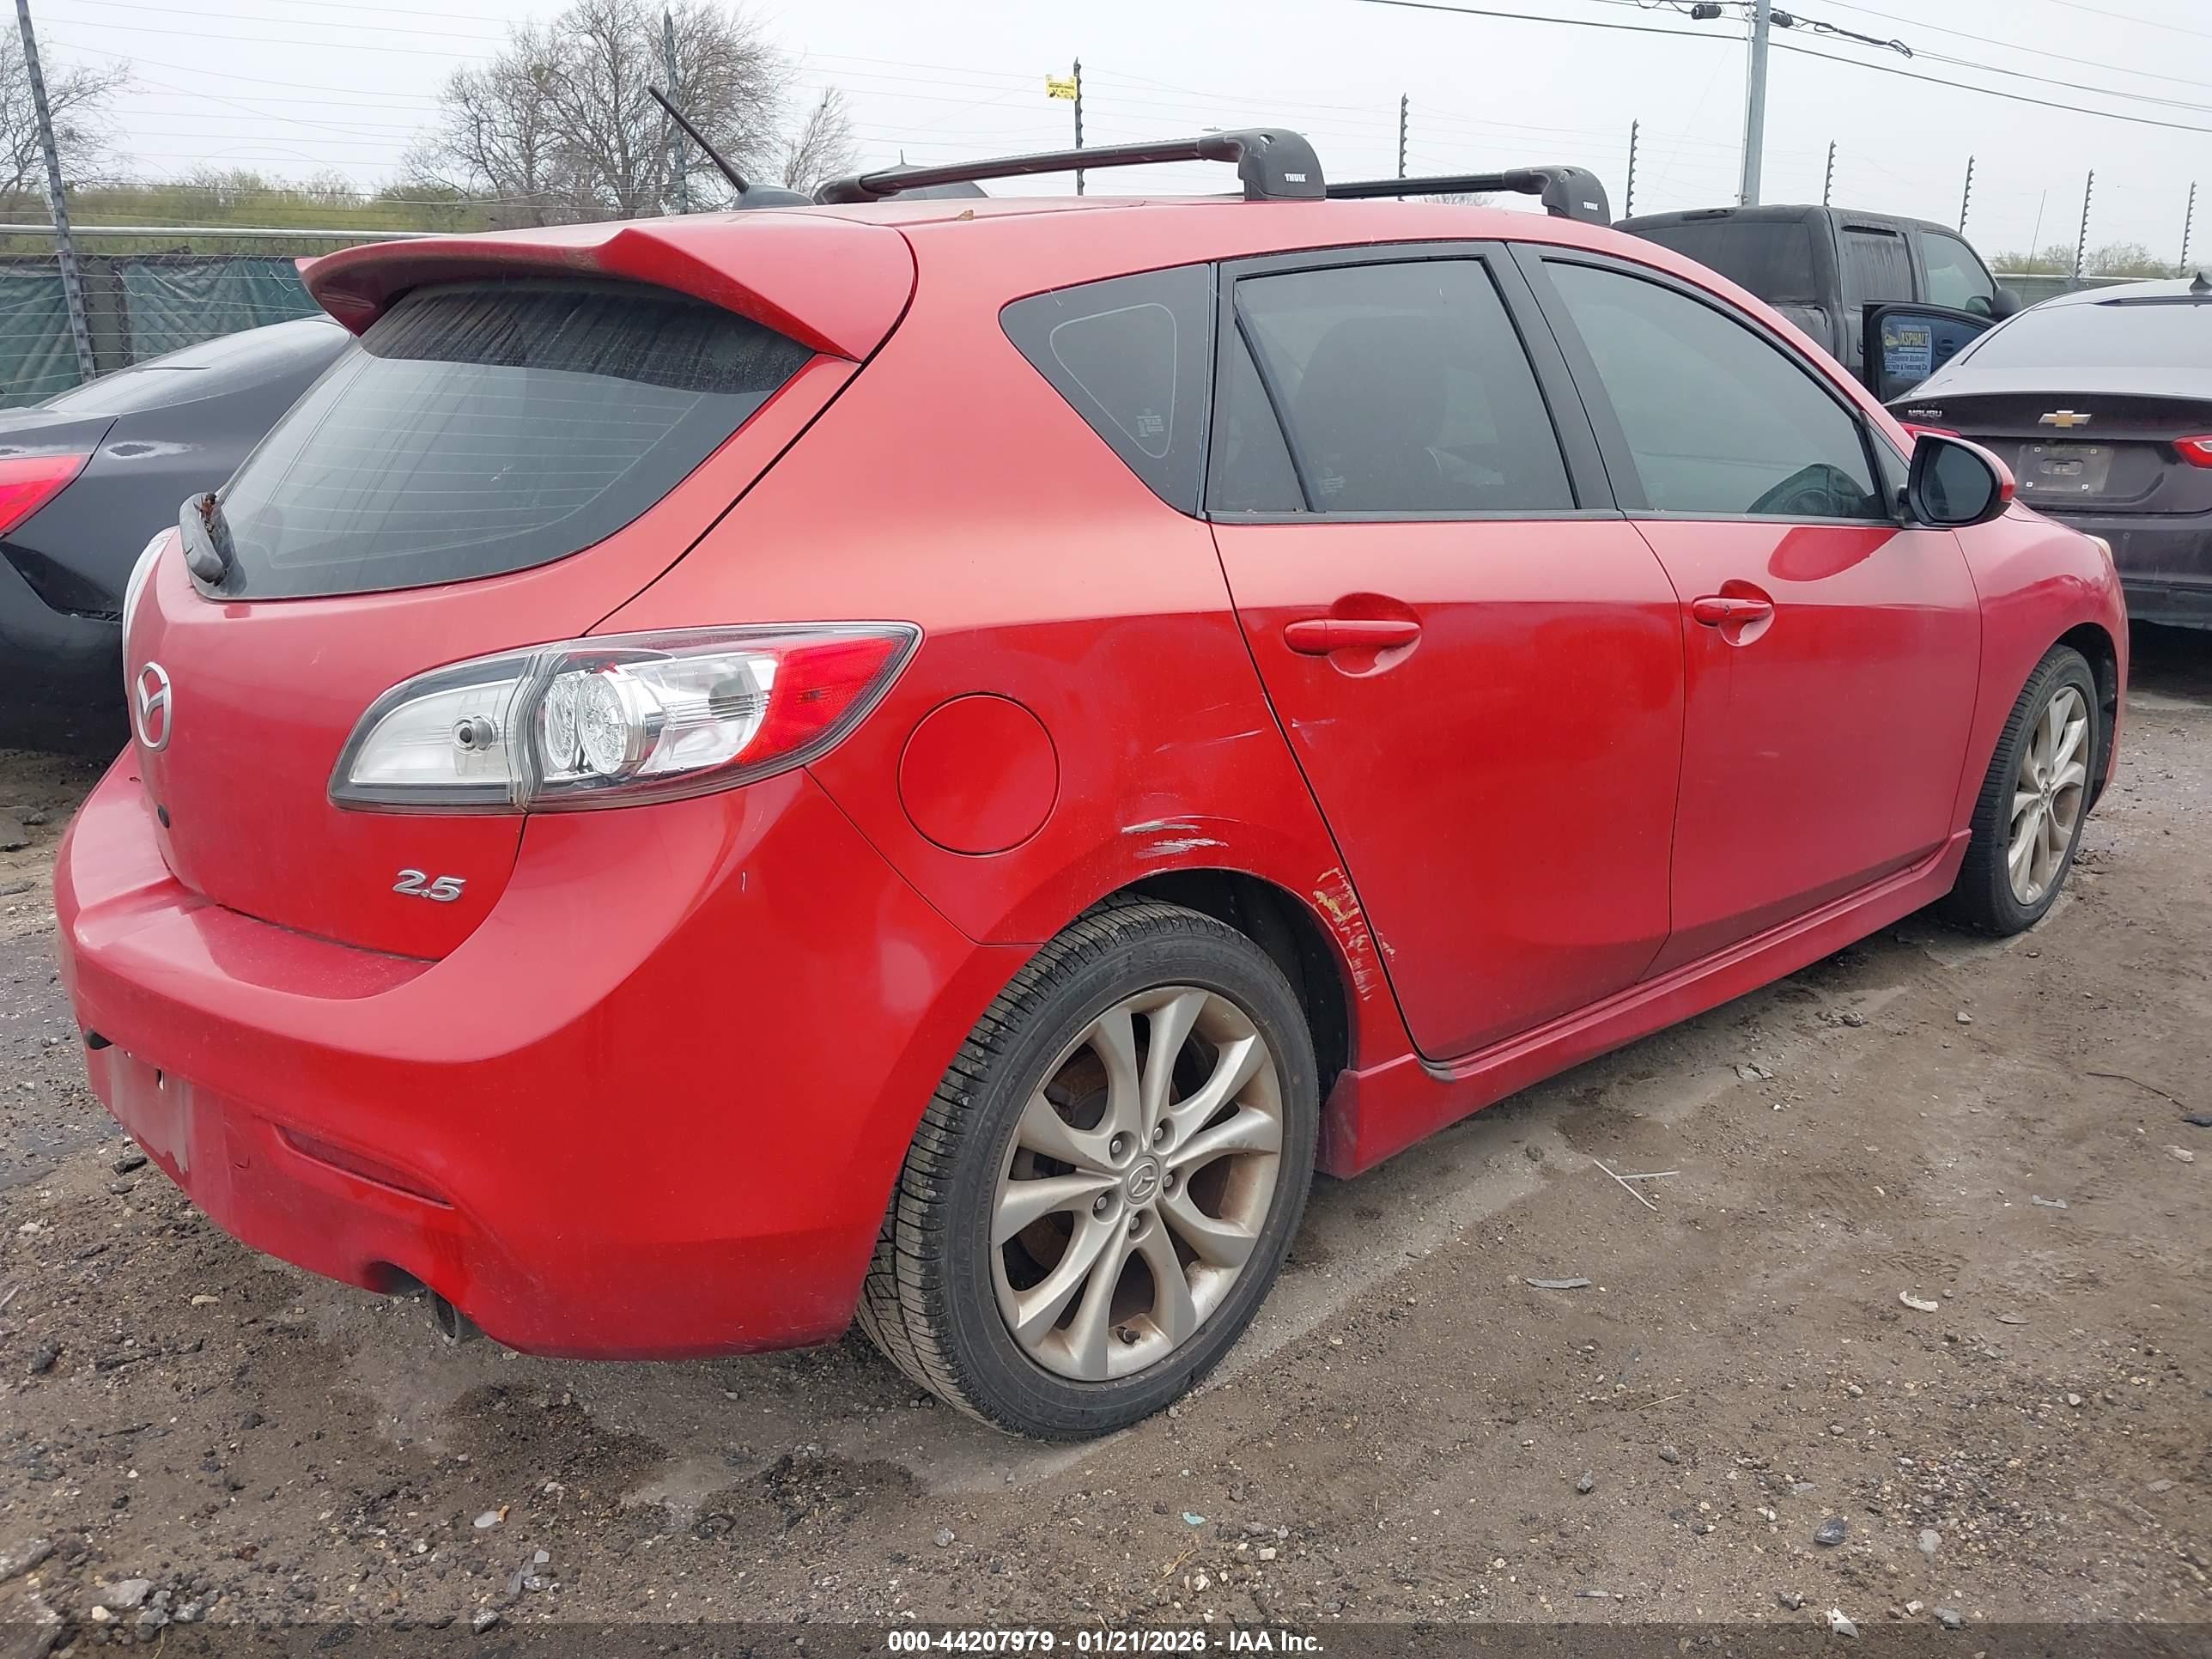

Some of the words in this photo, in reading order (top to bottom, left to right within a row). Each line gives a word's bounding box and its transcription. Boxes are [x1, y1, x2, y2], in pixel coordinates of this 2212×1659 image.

[1284, 173, 1306, 182] THULE
[1899, 331, 1929, 346] ASPHALT
[392, 869, 466, 902] 2.5
